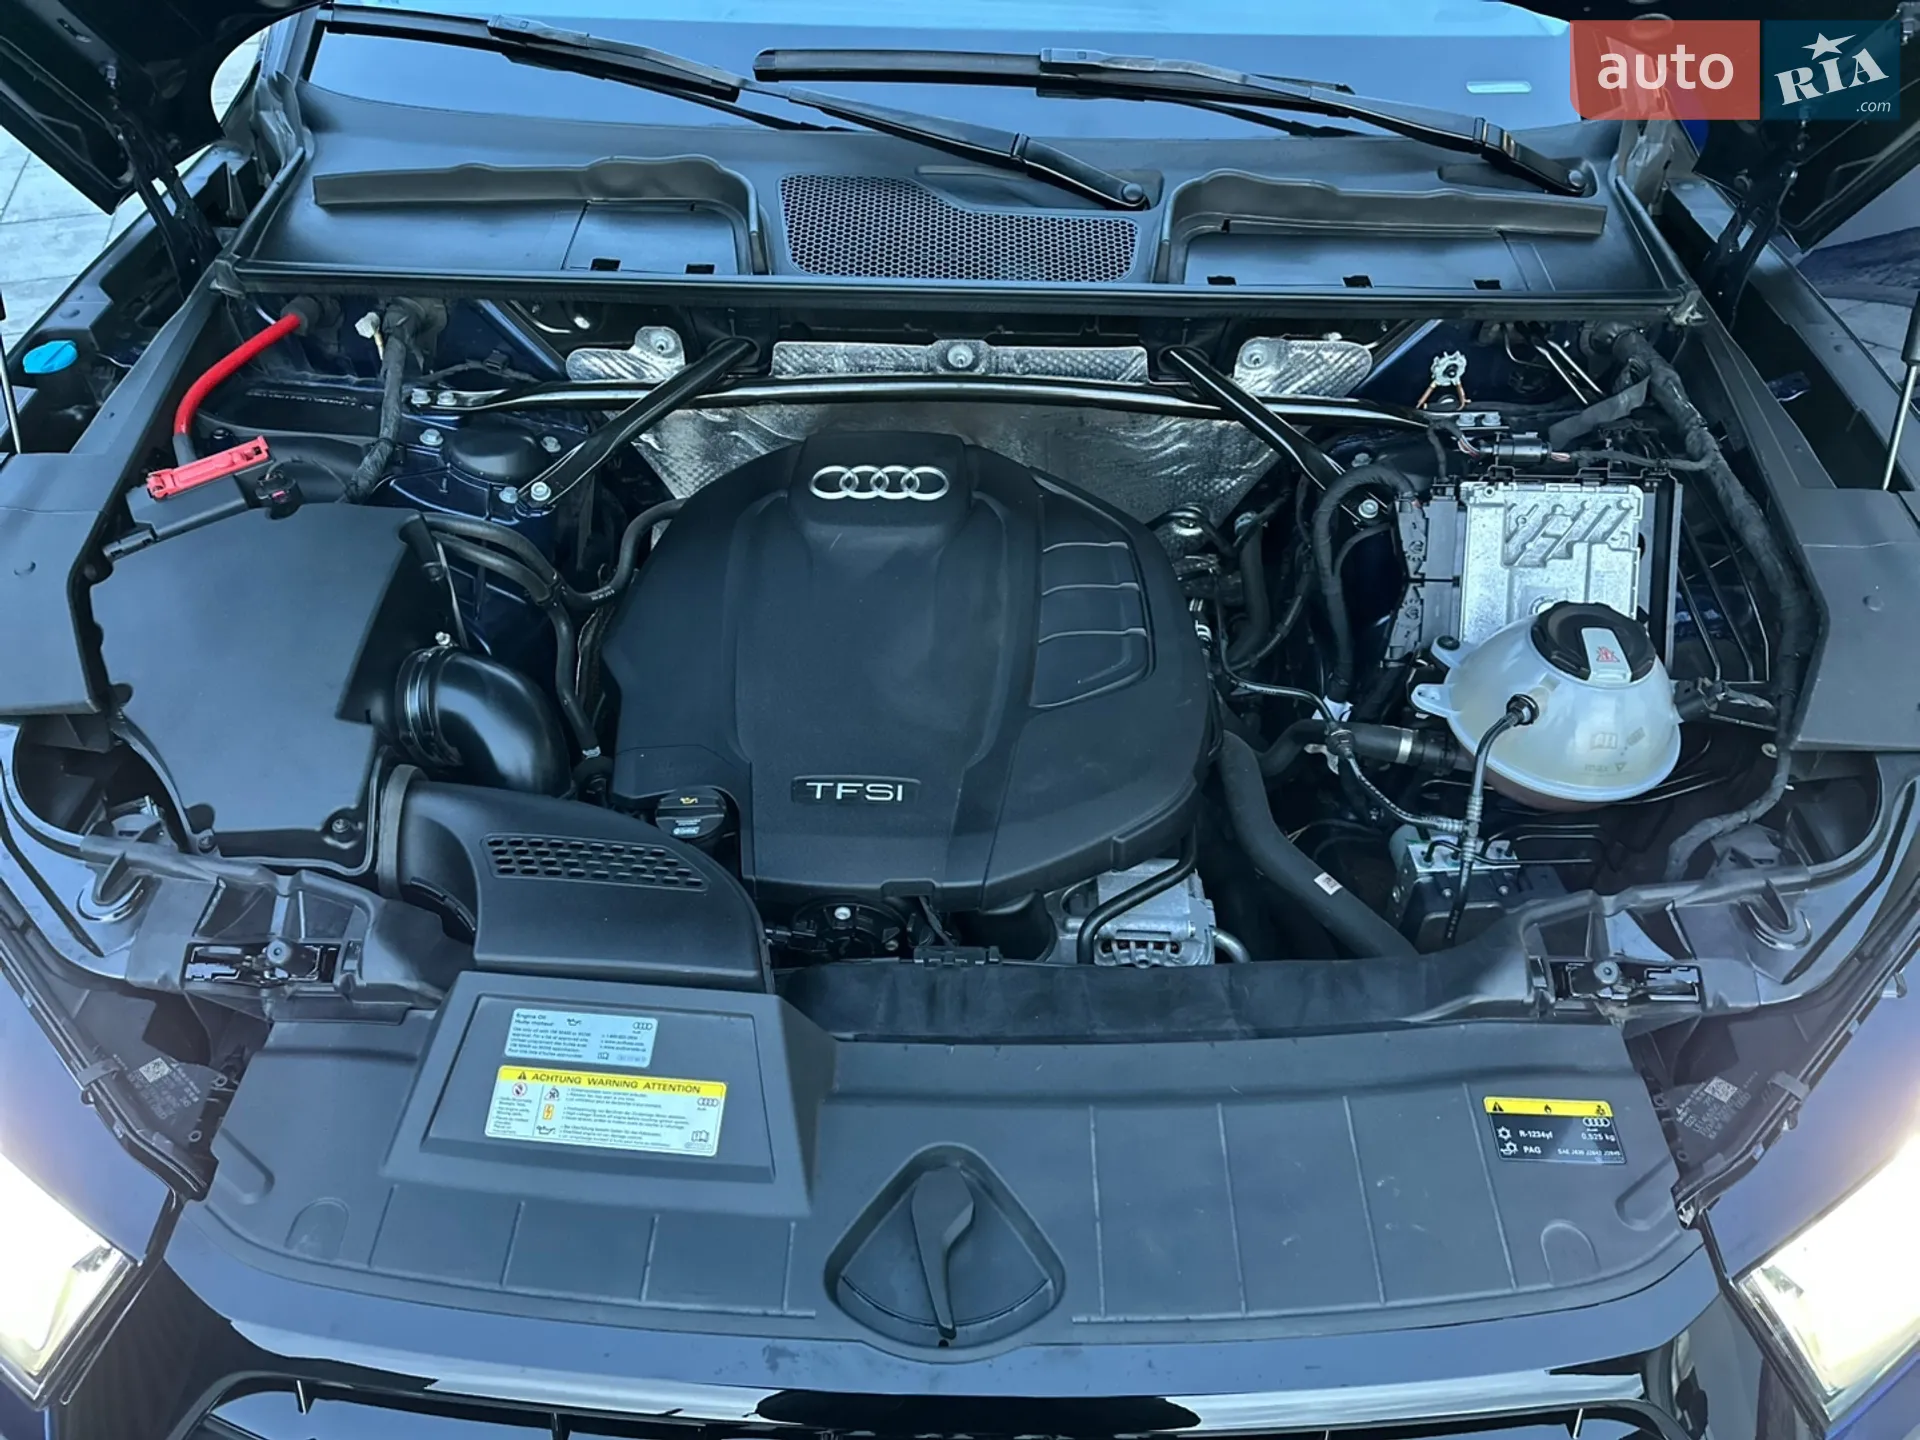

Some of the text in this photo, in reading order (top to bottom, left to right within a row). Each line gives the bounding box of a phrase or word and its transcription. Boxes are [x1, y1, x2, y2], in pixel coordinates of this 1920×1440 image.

[1584, 763, 1608, 772] max
[805, 782, 903, 801] TFSI
[531, 1073, 582, 1085] ACHTUNG
[587, 1077, 638, 1089] WARNING
[643, 1082, 701, 1094] ATTENTION
[1523, 1145, 1542, 1154] PAG
